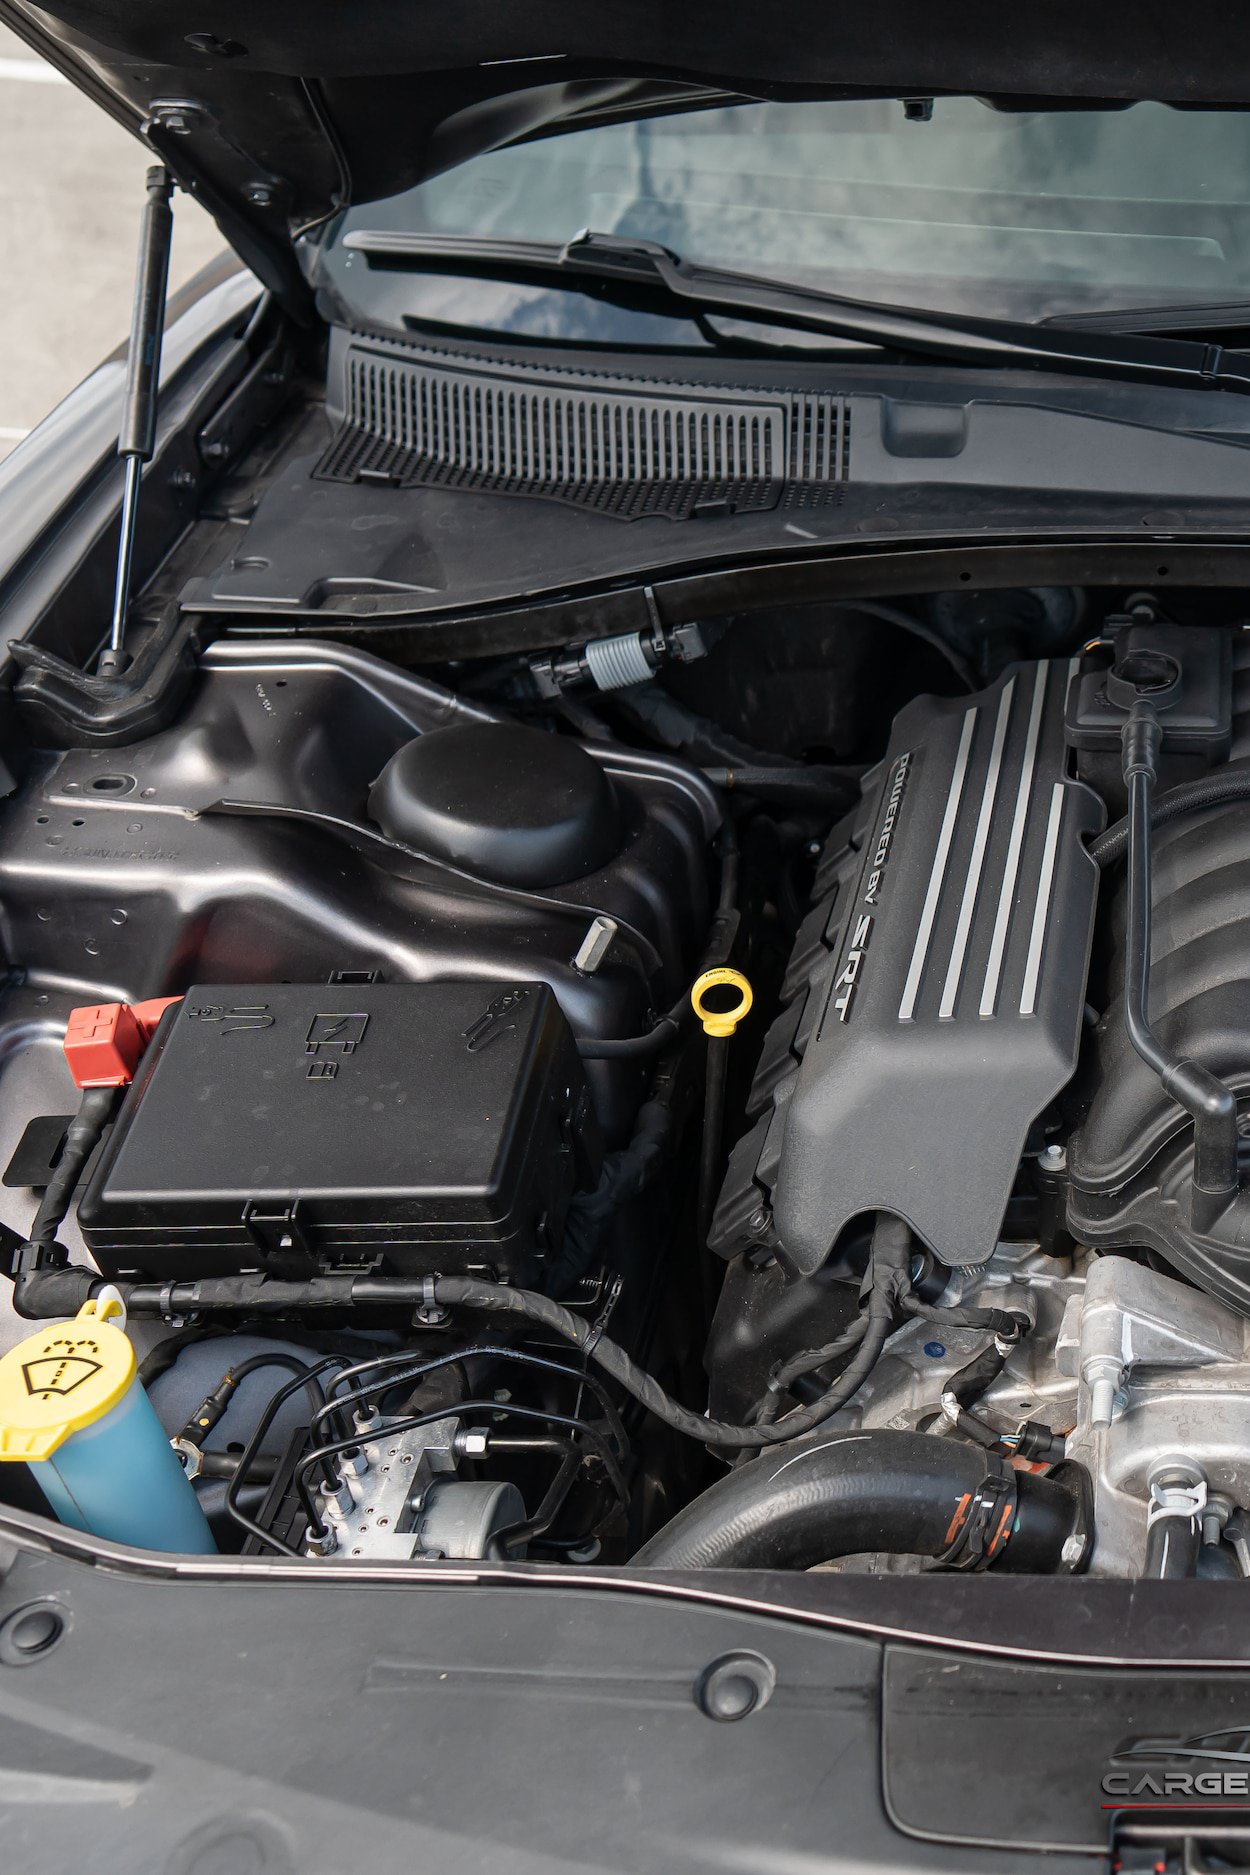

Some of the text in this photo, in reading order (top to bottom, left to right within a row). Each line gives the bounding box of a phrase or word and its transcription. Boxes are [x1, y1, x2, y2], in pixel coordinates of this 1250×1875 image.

[834, 752, 911, 1023] POWERED BY SRT
